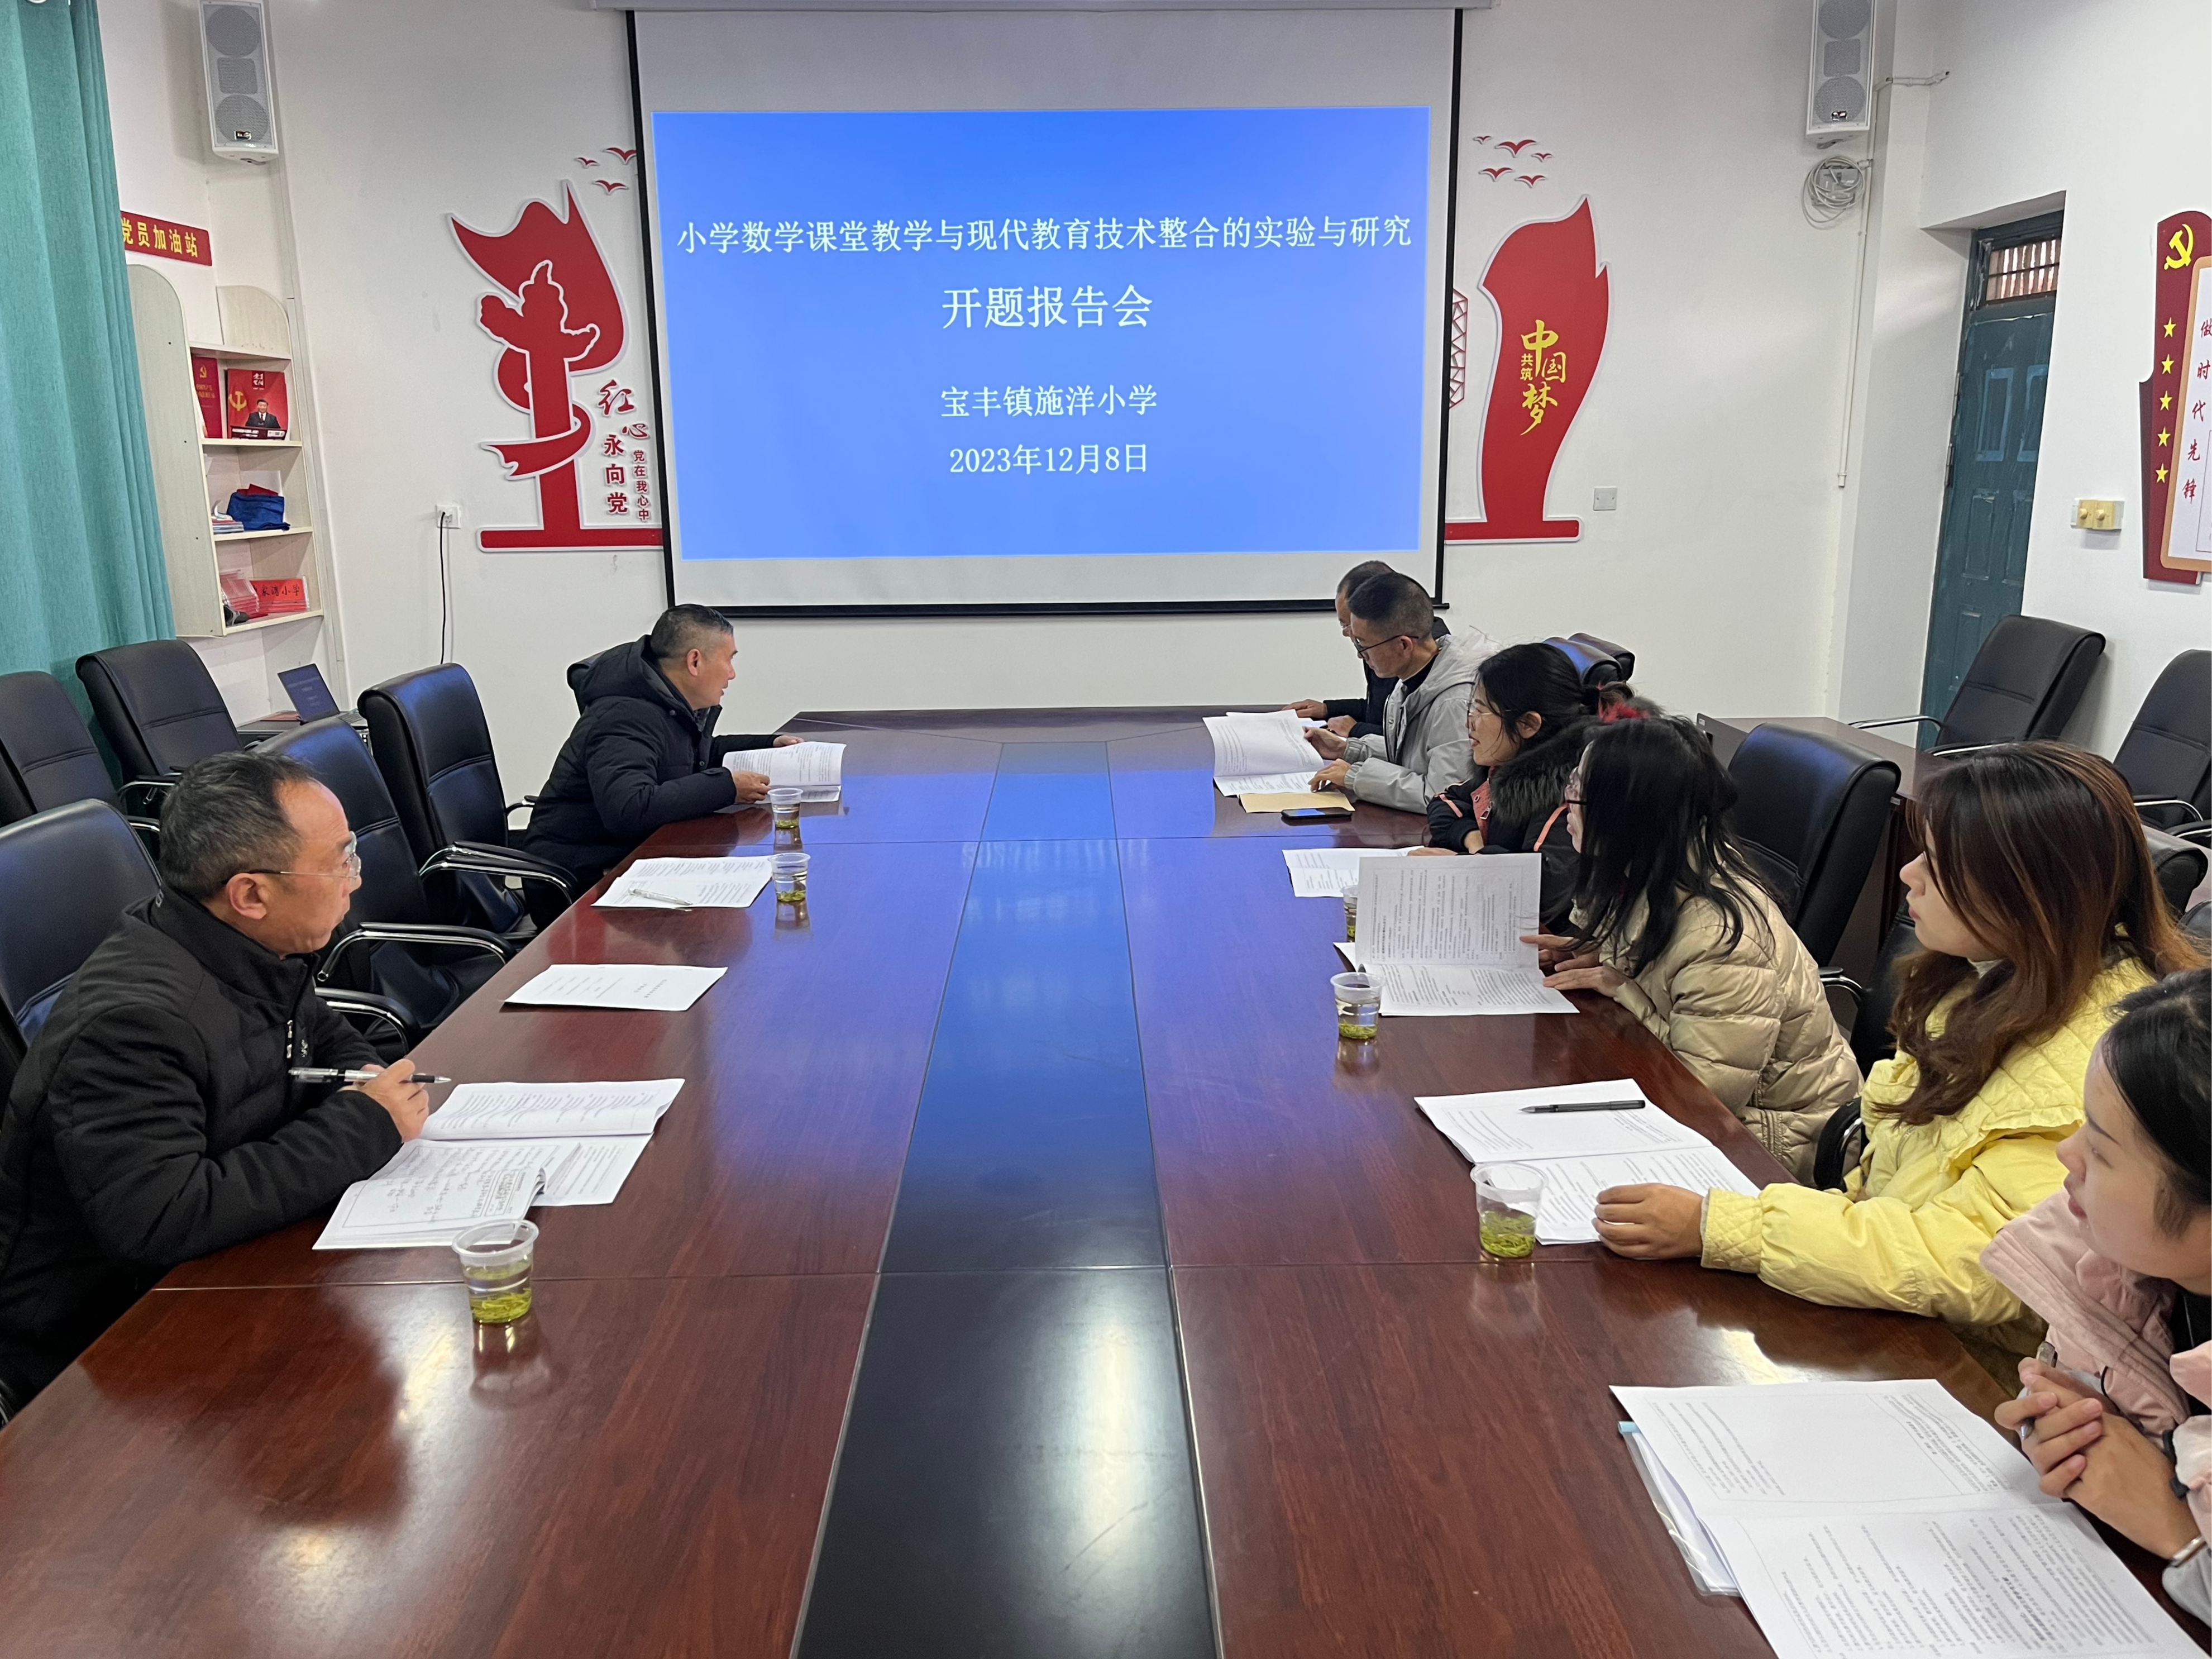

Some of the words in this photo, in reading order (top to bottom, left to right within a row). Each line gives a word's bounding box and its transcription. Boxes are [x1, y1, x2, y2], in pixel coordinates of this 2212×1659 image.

[121, 217, 198, 258] 党员加油站
[677, 214, 1412, 254] 小学数学课堂教学与现代教育技术整合的实验与研究
[942, 284, 1153, 329] 开题报告会
[1520, 353, 1533, 382] 共筑
[940, 384, 1158, 418] 宝丰镇施洋小学
[949, 443, 1149, 475] 2023年12月8日
[633, 449, 651, 521] 党在我心中
